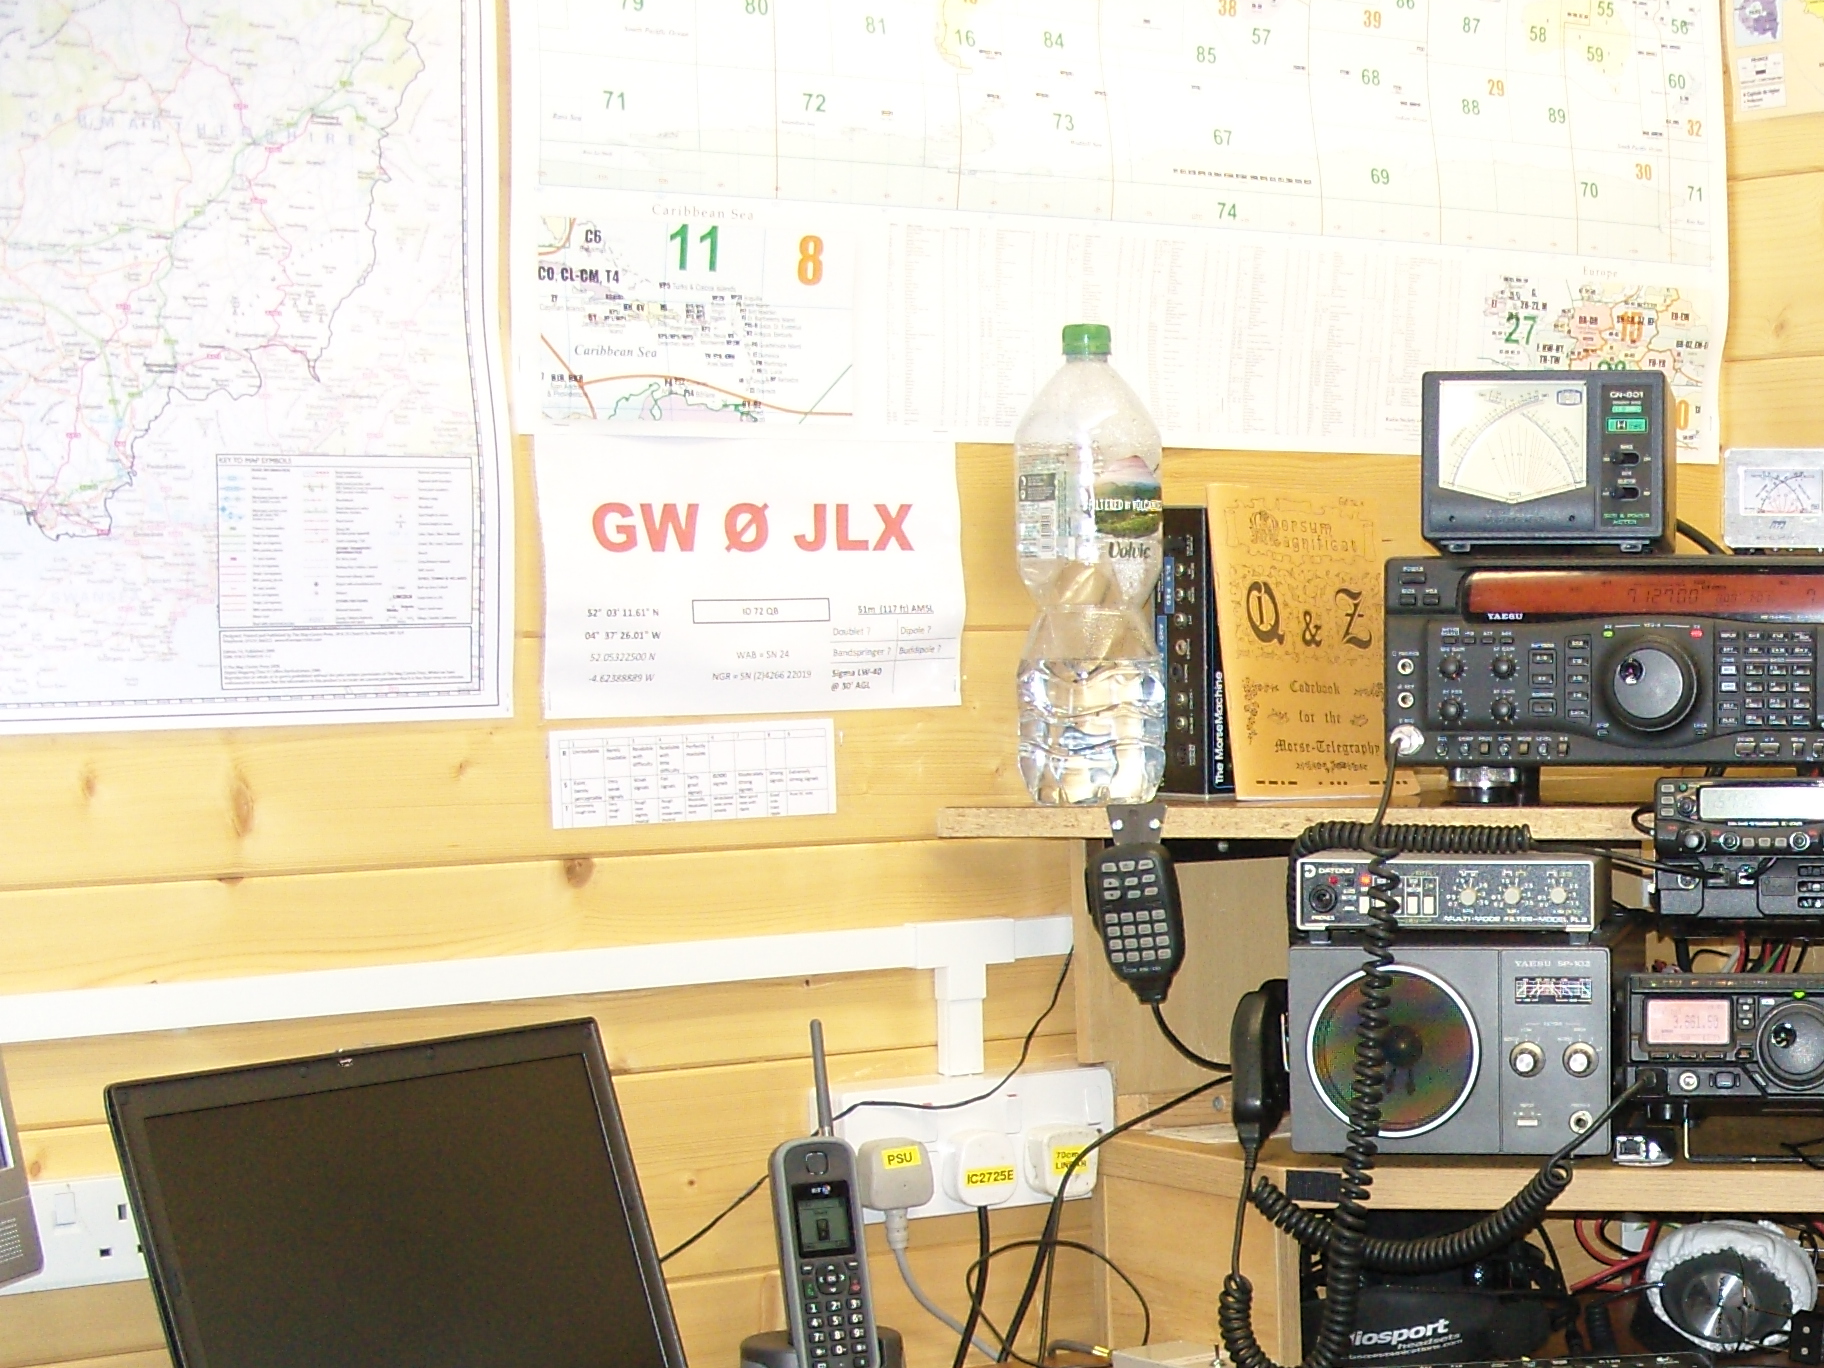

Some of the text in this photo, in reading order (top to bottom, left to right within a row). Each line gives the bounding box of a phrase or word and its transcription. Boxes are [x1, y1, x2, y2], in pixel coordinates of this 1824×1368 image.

[866, 16, 887, 35] 81
[1363, 9, 1382, 29] 39
[1462, 16, 1481, 34] 87
[955, 29, 976, 48] 16
[1043, 31, 1065, 50] 84
[1251, 28, 1272, 46] 57
[1529, 26, 1548, 43] 58
[1196, 45, 1217, 65] 85
[1586, 46, 1605, 64] 59
[1361, 69, 1381, 87] 68
[1668, 73, 1686, 91] 60
[1487, 79, 1505, 97] 29
[602, 90, 627, 112] 71
[802, 92, 827, 113] 72
[1461, 98, 1481, 116] 88
[1052, 113, 1075, 132] 73
[1548, 108, 1567, 125] 89
[1687, 119, 1703, 137] 32
[1213, 129, 1232, 147] 67
[1370, 167, 1390, 186] 69
[1635, 162, 1653, 181] 30
[1580, 181, 1599, 199] 70
[1686, 185, 1704, 203] 71
[651, 204, 754, 221] Caribbean Sea
[1217, 201, 1238, 220] 74
[585, 229, 602, 245] C6
[669, 222, 719, 272] 11
[797, 234, 824, 286] 8
[1583, 265, 1618, 279] Europe
[1504, 313, 1538, 346] 27
[574, 344, 658, 358] Caribbean Sea
[218, 457, 232, 465] KEY
[234, 457, 243, 465] TO
[261, 457, 292, 465] SYMBOLS
[592, 502, 699, 553] GW
[793, 503, 915, 552] JLX
[1108, 541, 1151, 558] Volvic
[1289, 681, 1341, 694] Codebook
[1299, 710, 1341, 724] for the
[1274, 739, 1380, 755] Morse-Telegraphy
[1214, 764, 1224, 785] The
[887, 1152, 913, 1165] PSU
[967, 1170, 1014, 1184] IC2725E
[1397, 1333, 1461, 1350] headsets
